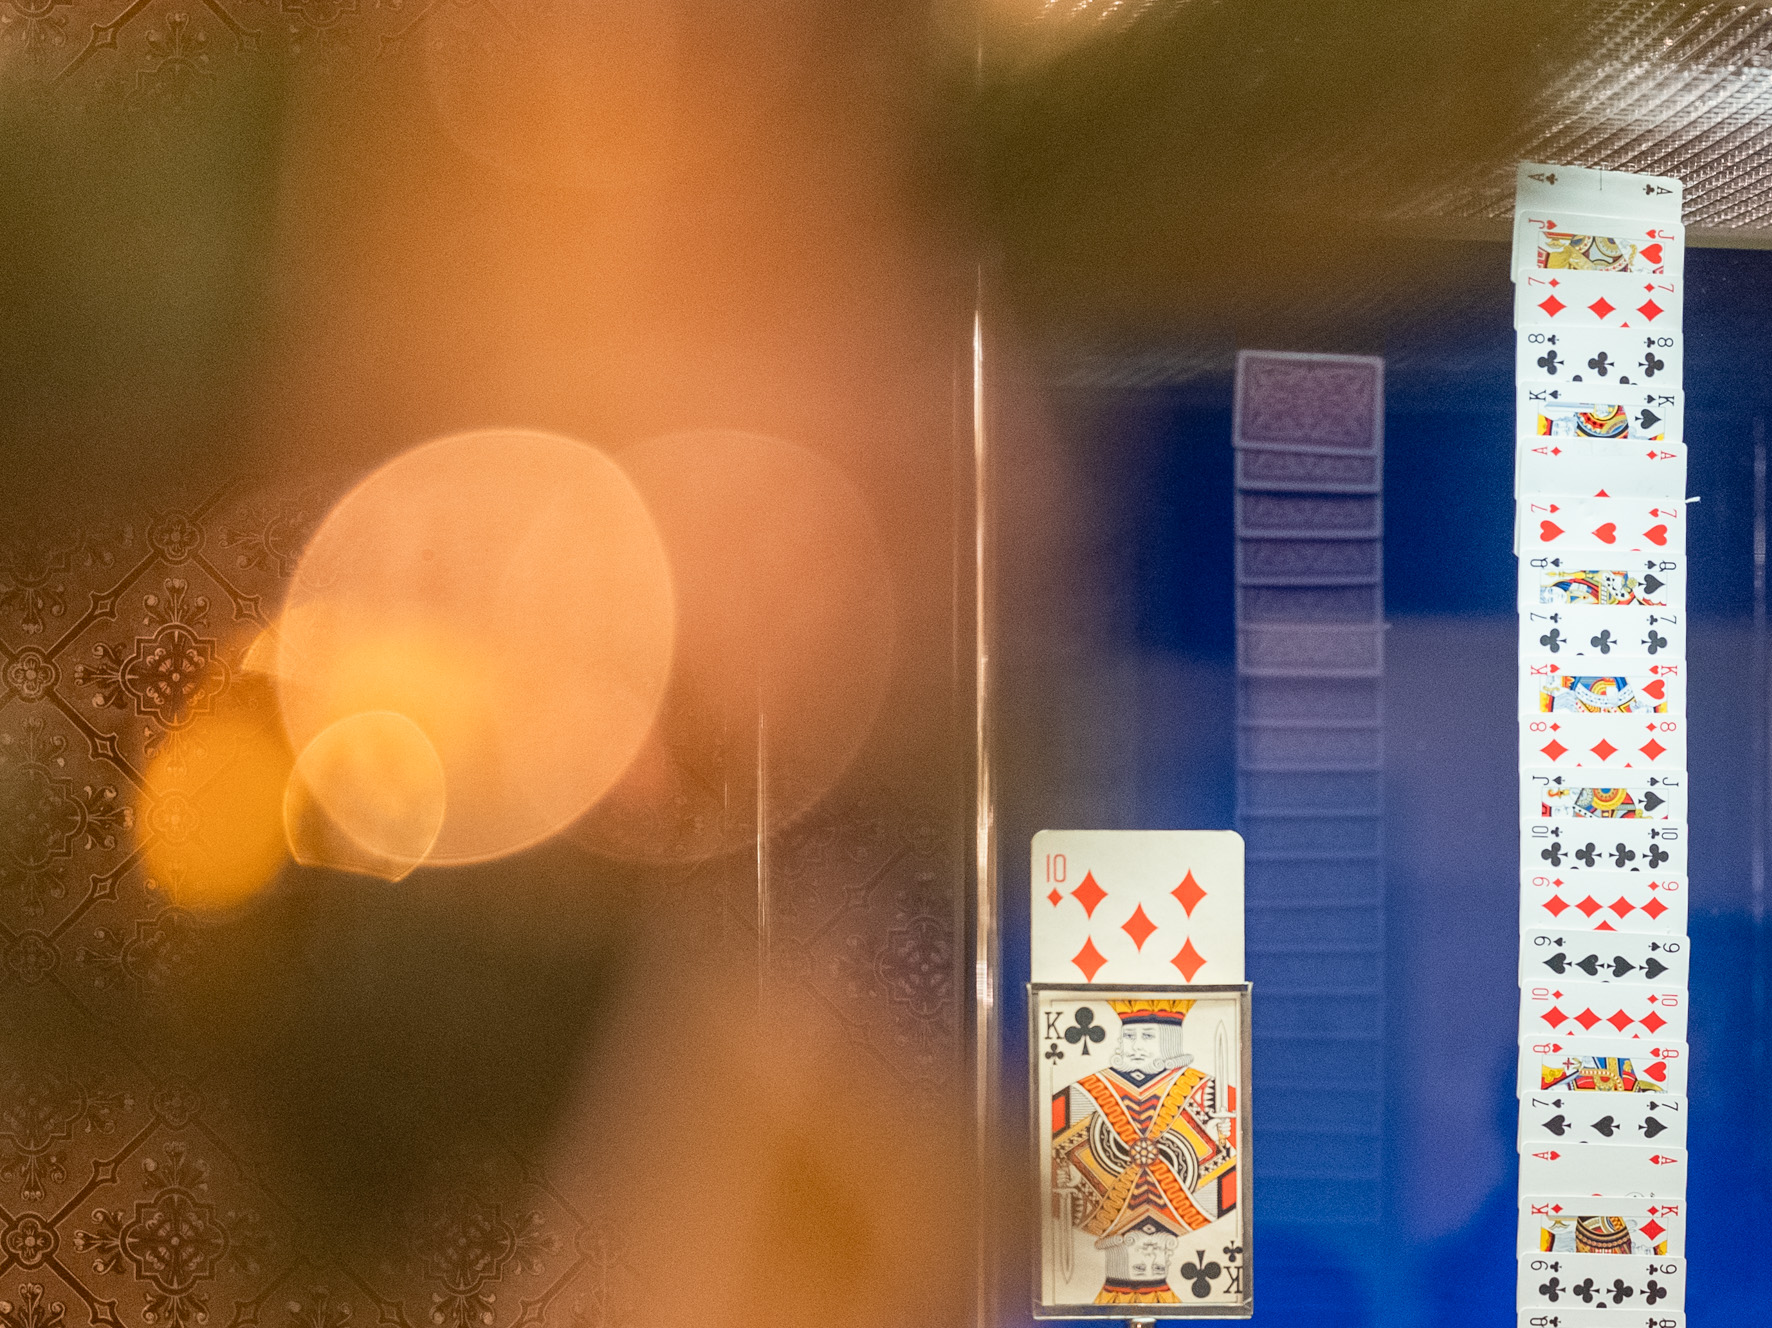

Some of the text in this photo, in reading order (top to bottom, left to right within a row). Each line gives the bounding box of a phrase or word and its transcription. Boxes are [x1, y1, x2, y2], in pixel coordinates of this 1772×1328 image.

[1527, 173, 1544, 182] A
[1657, 186, 1673, 195] A
[1529, 218, 1545, 229] J
[1658, 230, 1674, 240] J
[1528, 277, 1545, 286] 7
[1658, 284, 1674, 292] 7
[1528, 334, 1545, 343] 8
[1657, 338, 1673, 347] 8
[1530, 390, 1546, 401] K
[1658, 395, 1674, 406] K
[1531, 447, 1547, 455] A
[1660, 451, 1676, 460] A
[1531, 504, 1548, 512] 7
[1661, 509, 1677, 518] 7
[1530, 558, 1548, 568] Q
[1659, 561, 1676, 572] Q
[1530, 613, 1547, 621] 7
[1661, 616, 1676, 624] 7
[1531, 664, 1547, 675] K
[1662, 665, 1677, 676] K
[1530, 722, 1546, 731] 8
[1660, 722, 1676, 732] 8
[1533, 776, 1549, 785] J
[1663, 777, 1679, 786] J
[1532, 826, 1548, 838] 10
[1662, 828, 1678, 840] 10
[1046, 853, 1067, 883] 10
[1532, 988, 1549, 1000] 10
[1662, 994, 1678, 1007] 10
[1044, 1011, 1063, 1040] K
[1533, 1043, 1551, 1054] Q
[1662, 1048, 1679, 1059] Q
[1532, 1099, 1549, 1107] 7
[1662, 1102, 1678, 1111] 7
[1532, 1151, 1548, 1160] A
[1661, 1156, 1678, 1165] A
[1532, 1204, 1549, 1215] K
[1662, 1205, 1678, 1216] K
[1223, 1266, 1243, 1294] K
[1530, 1316, 1548, 1327] Q
